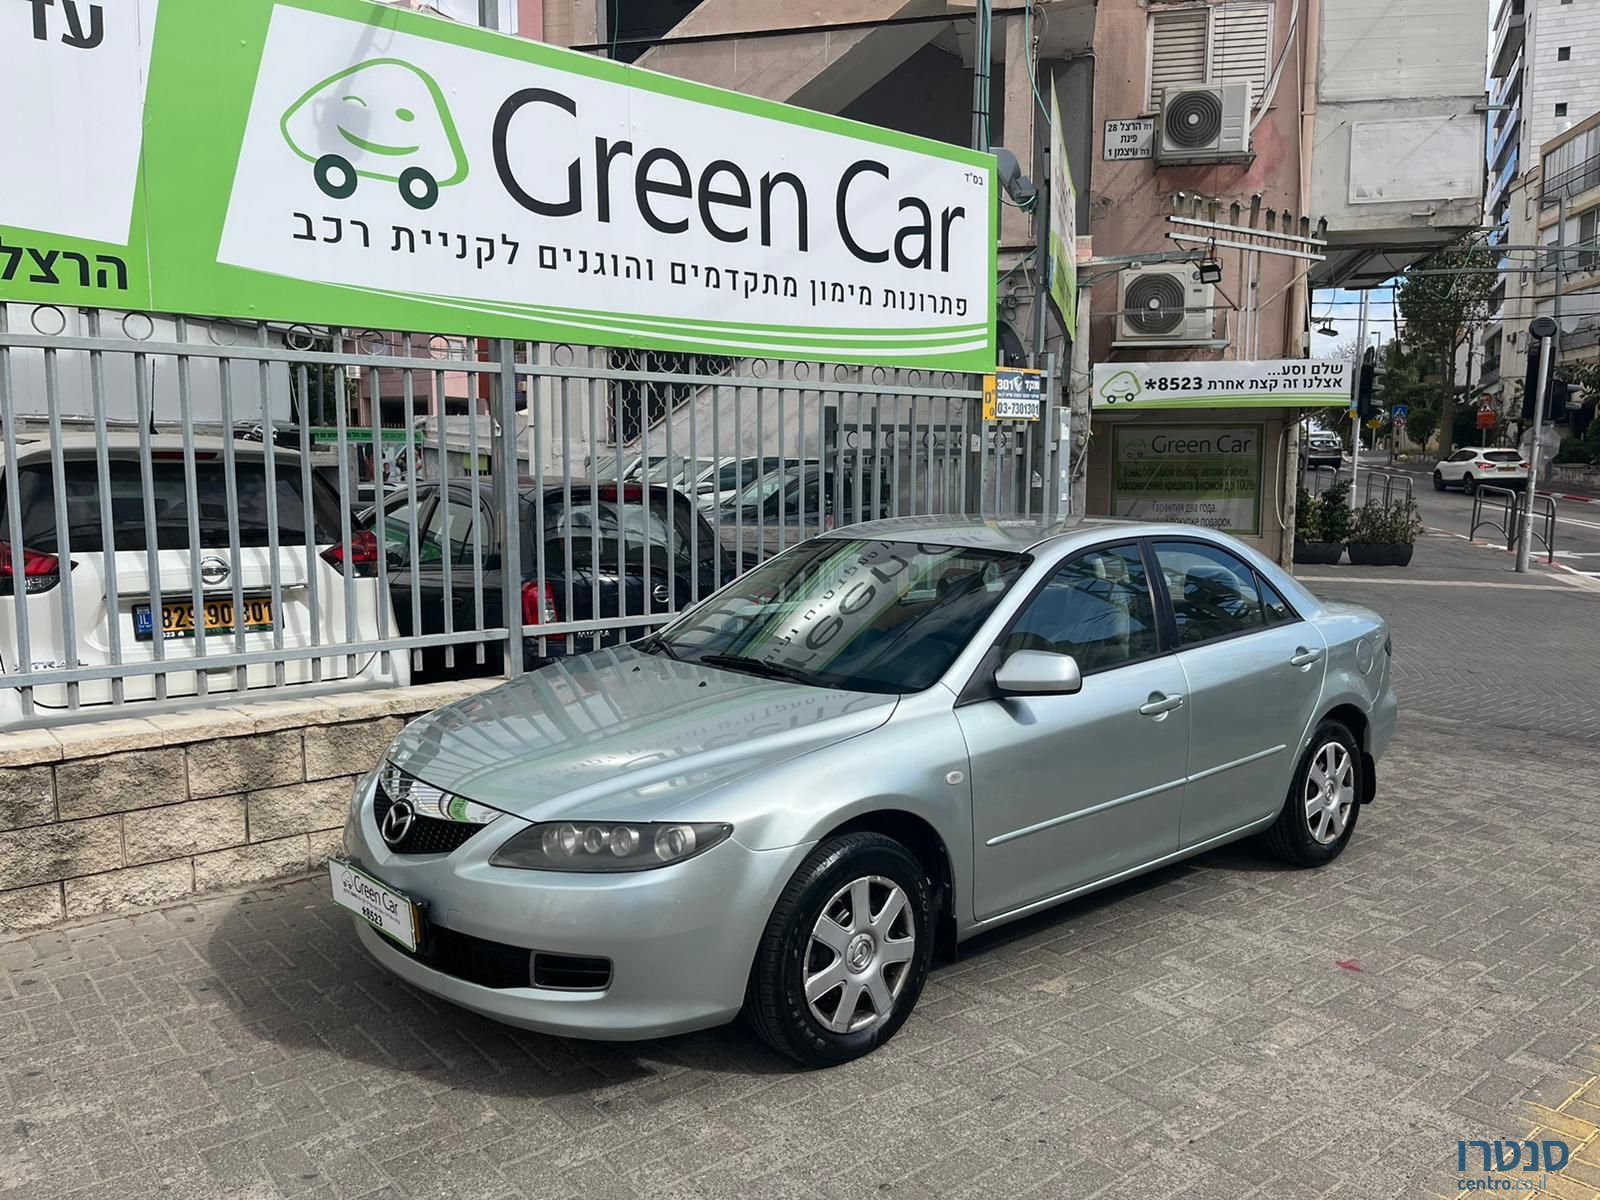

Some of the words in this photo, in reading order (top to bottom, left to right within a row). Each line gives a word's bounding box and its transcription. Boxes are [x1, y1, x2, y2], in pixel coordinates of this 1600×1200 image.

[1108, 124, 1118, 132] 28
[1120, 122, 1141, 131] הרצל
[1120, 134, 1138, 143] פינת
[1108, 149, 1112, 157] 1
[491, 87, 808, 252] Green
[835, 159, 966, 272] Car
[964, 172, 983, 186] בס"ד
[293, 211, 370, 247] רכב
[391, 225, 520, 269] לקניית
[538, 244, 653, 281] והוגנים
[671, 261, 797, 299] מתקדמים
[810, 279, 872, 306] מימון
[883, 288, 967, 317] פתרונות
[1268, 365, 1306, 376] וסע...
[1311, 362, 1343, 375] שלם
[997, 379, 1014, 390] 301
[1207, 379, 1245, 390] אחרת
[1249, 378, 1278, 392] קצת
[1283, 378, 1299, 388] זה
[1302, 376, 1343, 389] אצלנו
[1152, 435, 1211, 454] Green
[1216, 434, 1252, 453] Car
[1152, 502, 1184, 515] Гарантия
[1184, 503, 1198, 515] два
[140, 614, 150, 625] IL
[354, 875, 382, 906] Green
[382, 892, 398, 916] Car
